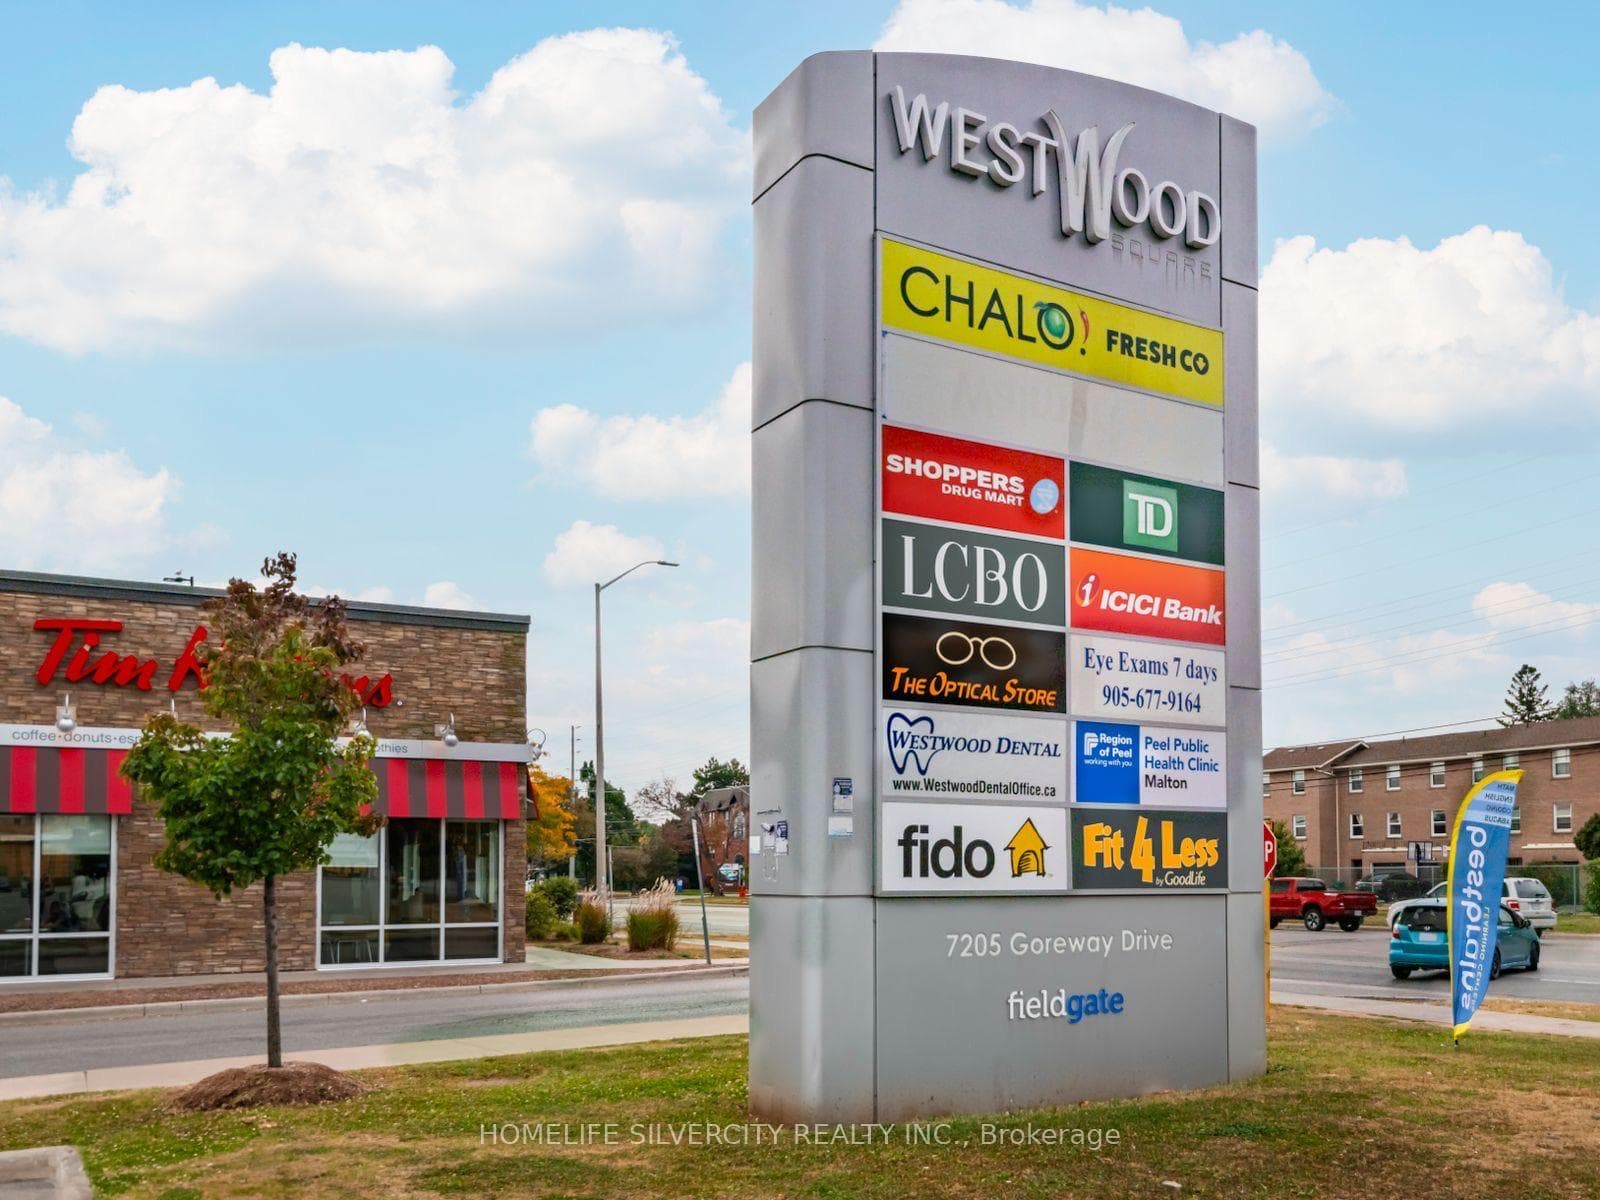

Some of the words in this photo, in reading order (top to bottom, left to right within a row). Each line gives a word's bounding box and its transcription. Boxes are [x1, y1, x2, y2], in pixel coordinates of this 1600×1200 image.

[888, 85, 1221, 249] WESTWOOD
[886, 454, 1025, 495] SHOPPERS
[941, 482, 982, 500] DRUG
[985, 491, 1024, 507] MART
[1128, 493, 1173, 537] TD
[901, 535, 1048, 612] LCBO
[1100, 588, 1161, 617] ICICI
[1163, 598, 1222, 625] Bank
[34, 619, 159, 691] Tim
[1083, 647, 1113, 676] Eye
[1119, 651, 1169, 676] Exams
[1173, 656, 1181, 677] 7
[1186, 659, 1218, 686] days
[891, 667, 927, 695] THE
[929, 671, 1000, 702] OPTICAL
[1003, 678, 1057, 706] STORE
[1103, 684, 1201, 713] 905-677-9164
[892, 730, 991, 753] WESTWOOD
[996, 737, 1061, 758] DENTAL
[1099, 747, 1110, 757] of
[1112, 748, 1132, 758] Peel
[1100, 733, 1132, 746] Region
[1145, 736, 1170, 751] Peel
[1174, 738, 1209, 753] Public
[1084, 758, 1107, 767] working
[1108, 758, 1120, 767] with
[1122, 760, 1132, 769] you
[1145, 756, 1184, 771] Health
[1188, 757, 1219, 772] Clinic
[893, 778, 1056, 797] www.WestwoodDentalOffice.ca
[1145, 774, 1188, 789] Malton
[897, 824, 996, 878] fido
[1083, 822, 1125, 870] Fit
[1130, 815, 1156, 883] 4
[1161, 820, 1220, 869] Less
[1155, 878, 1164, 887] by
[946, 933, 1002, 957] 7205
[1010, 931, 1114, 957] Goreway
[1121, 929, 1173, 952] Drive
[1007, 988, 1125, 1024] fieldgate
